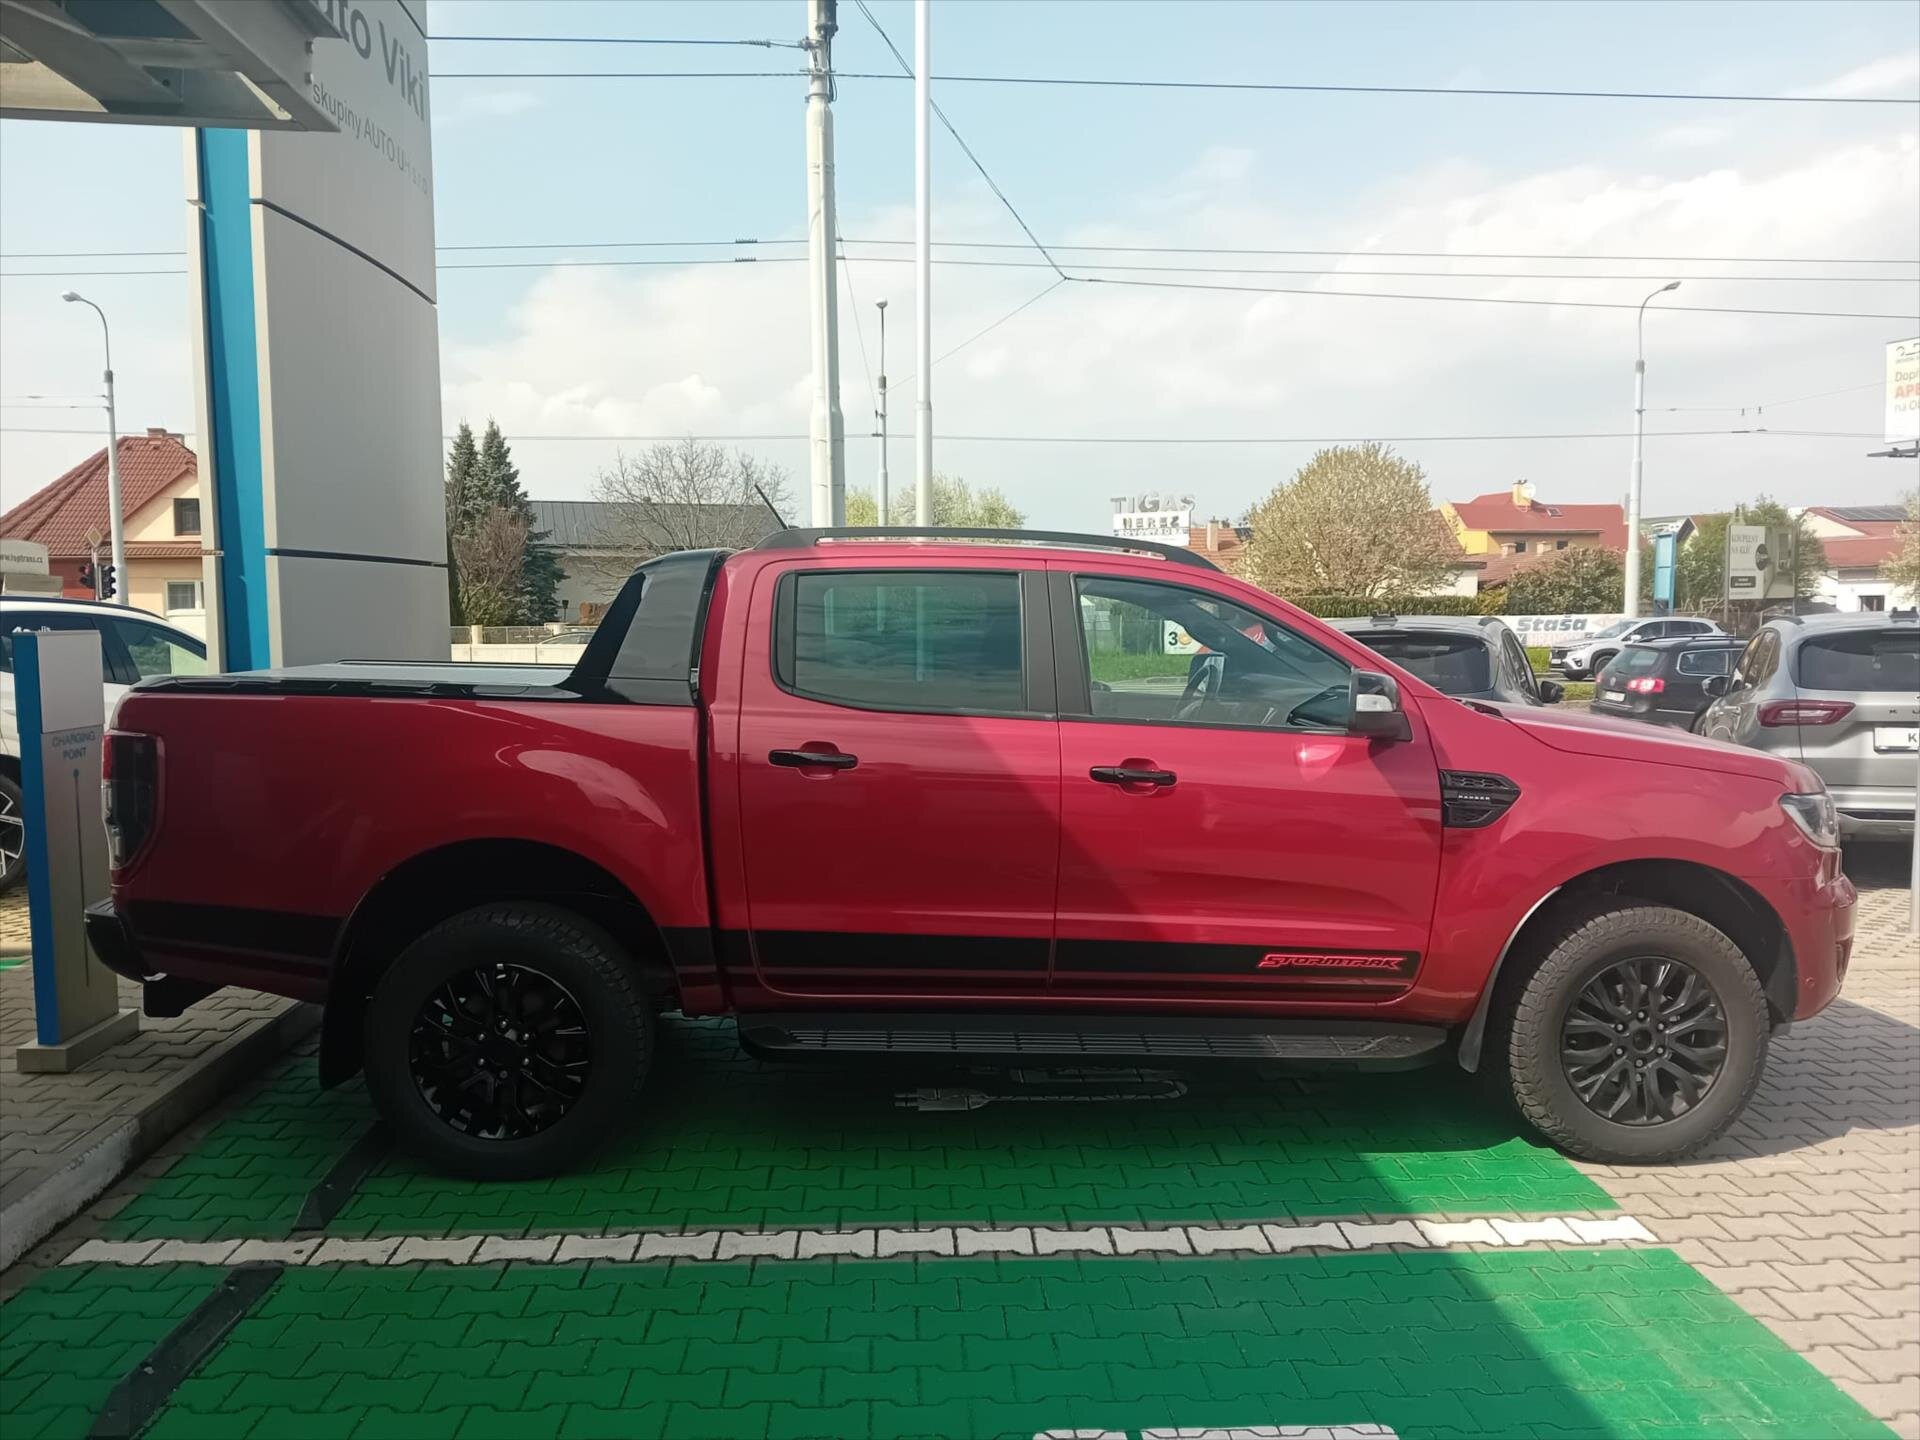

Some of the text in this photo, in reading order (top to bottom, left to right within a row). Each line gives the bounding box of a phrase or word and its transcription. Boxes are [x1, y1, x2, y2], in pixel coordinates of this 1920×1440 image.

[378, 19, 425, 122] Viki
[312, 82, 361, 140] skupiny
[363, 117, 395, 163] AUTO
[1110, 495, 1195, 513] TIGAS
[1516, 615, 1588, 632] Staša
[63, 747, 87, 760] POINT
